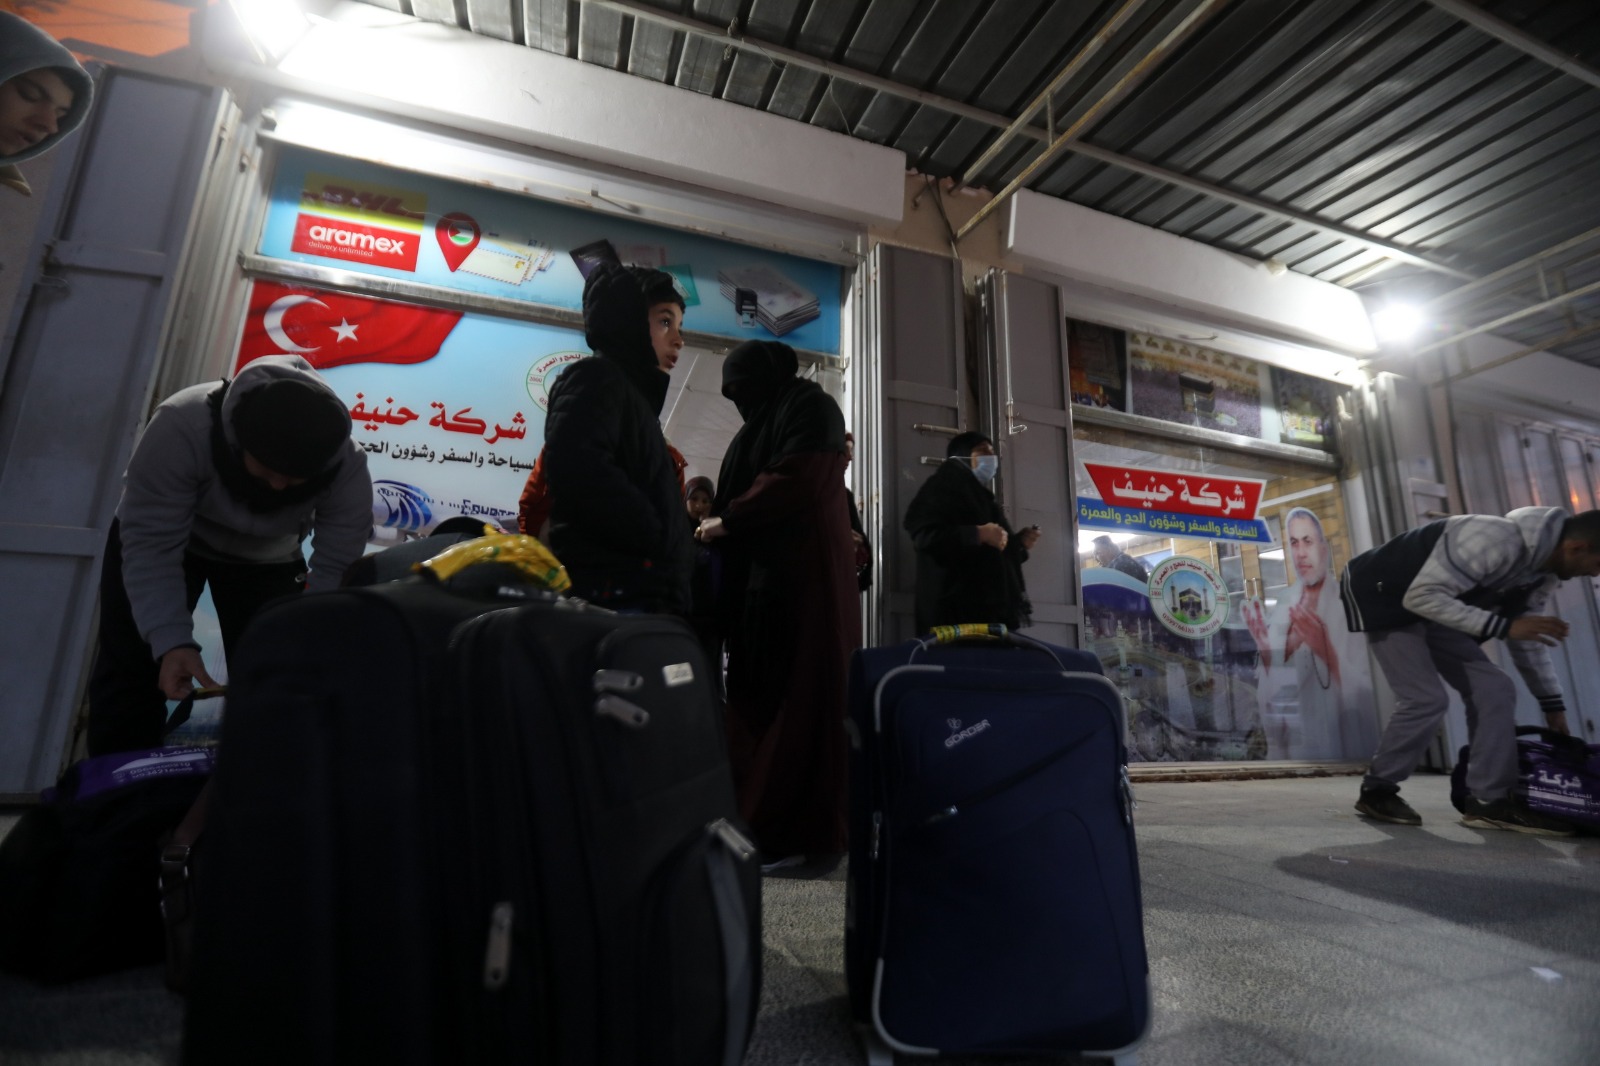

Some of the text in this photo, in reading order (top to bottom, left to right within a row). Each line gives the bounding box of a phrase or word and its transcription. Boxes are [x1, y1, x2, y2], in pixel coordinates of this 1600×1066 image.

[308, 239, 373, 258] delivery unlimited
[309, 224, 406, 256] aramex
[429, 401, 527, 445] شركة
[391, 441, 435, 463] وشؤون
[438, 452, 484, 468] والسفر
[1112, 471, 1246, 516] شركة حنيف
[1080, 506, 1258, 538] للسياحة والسفر وشؤون الحج والعمرة
[1538, 769, 1583, 790] شركة
